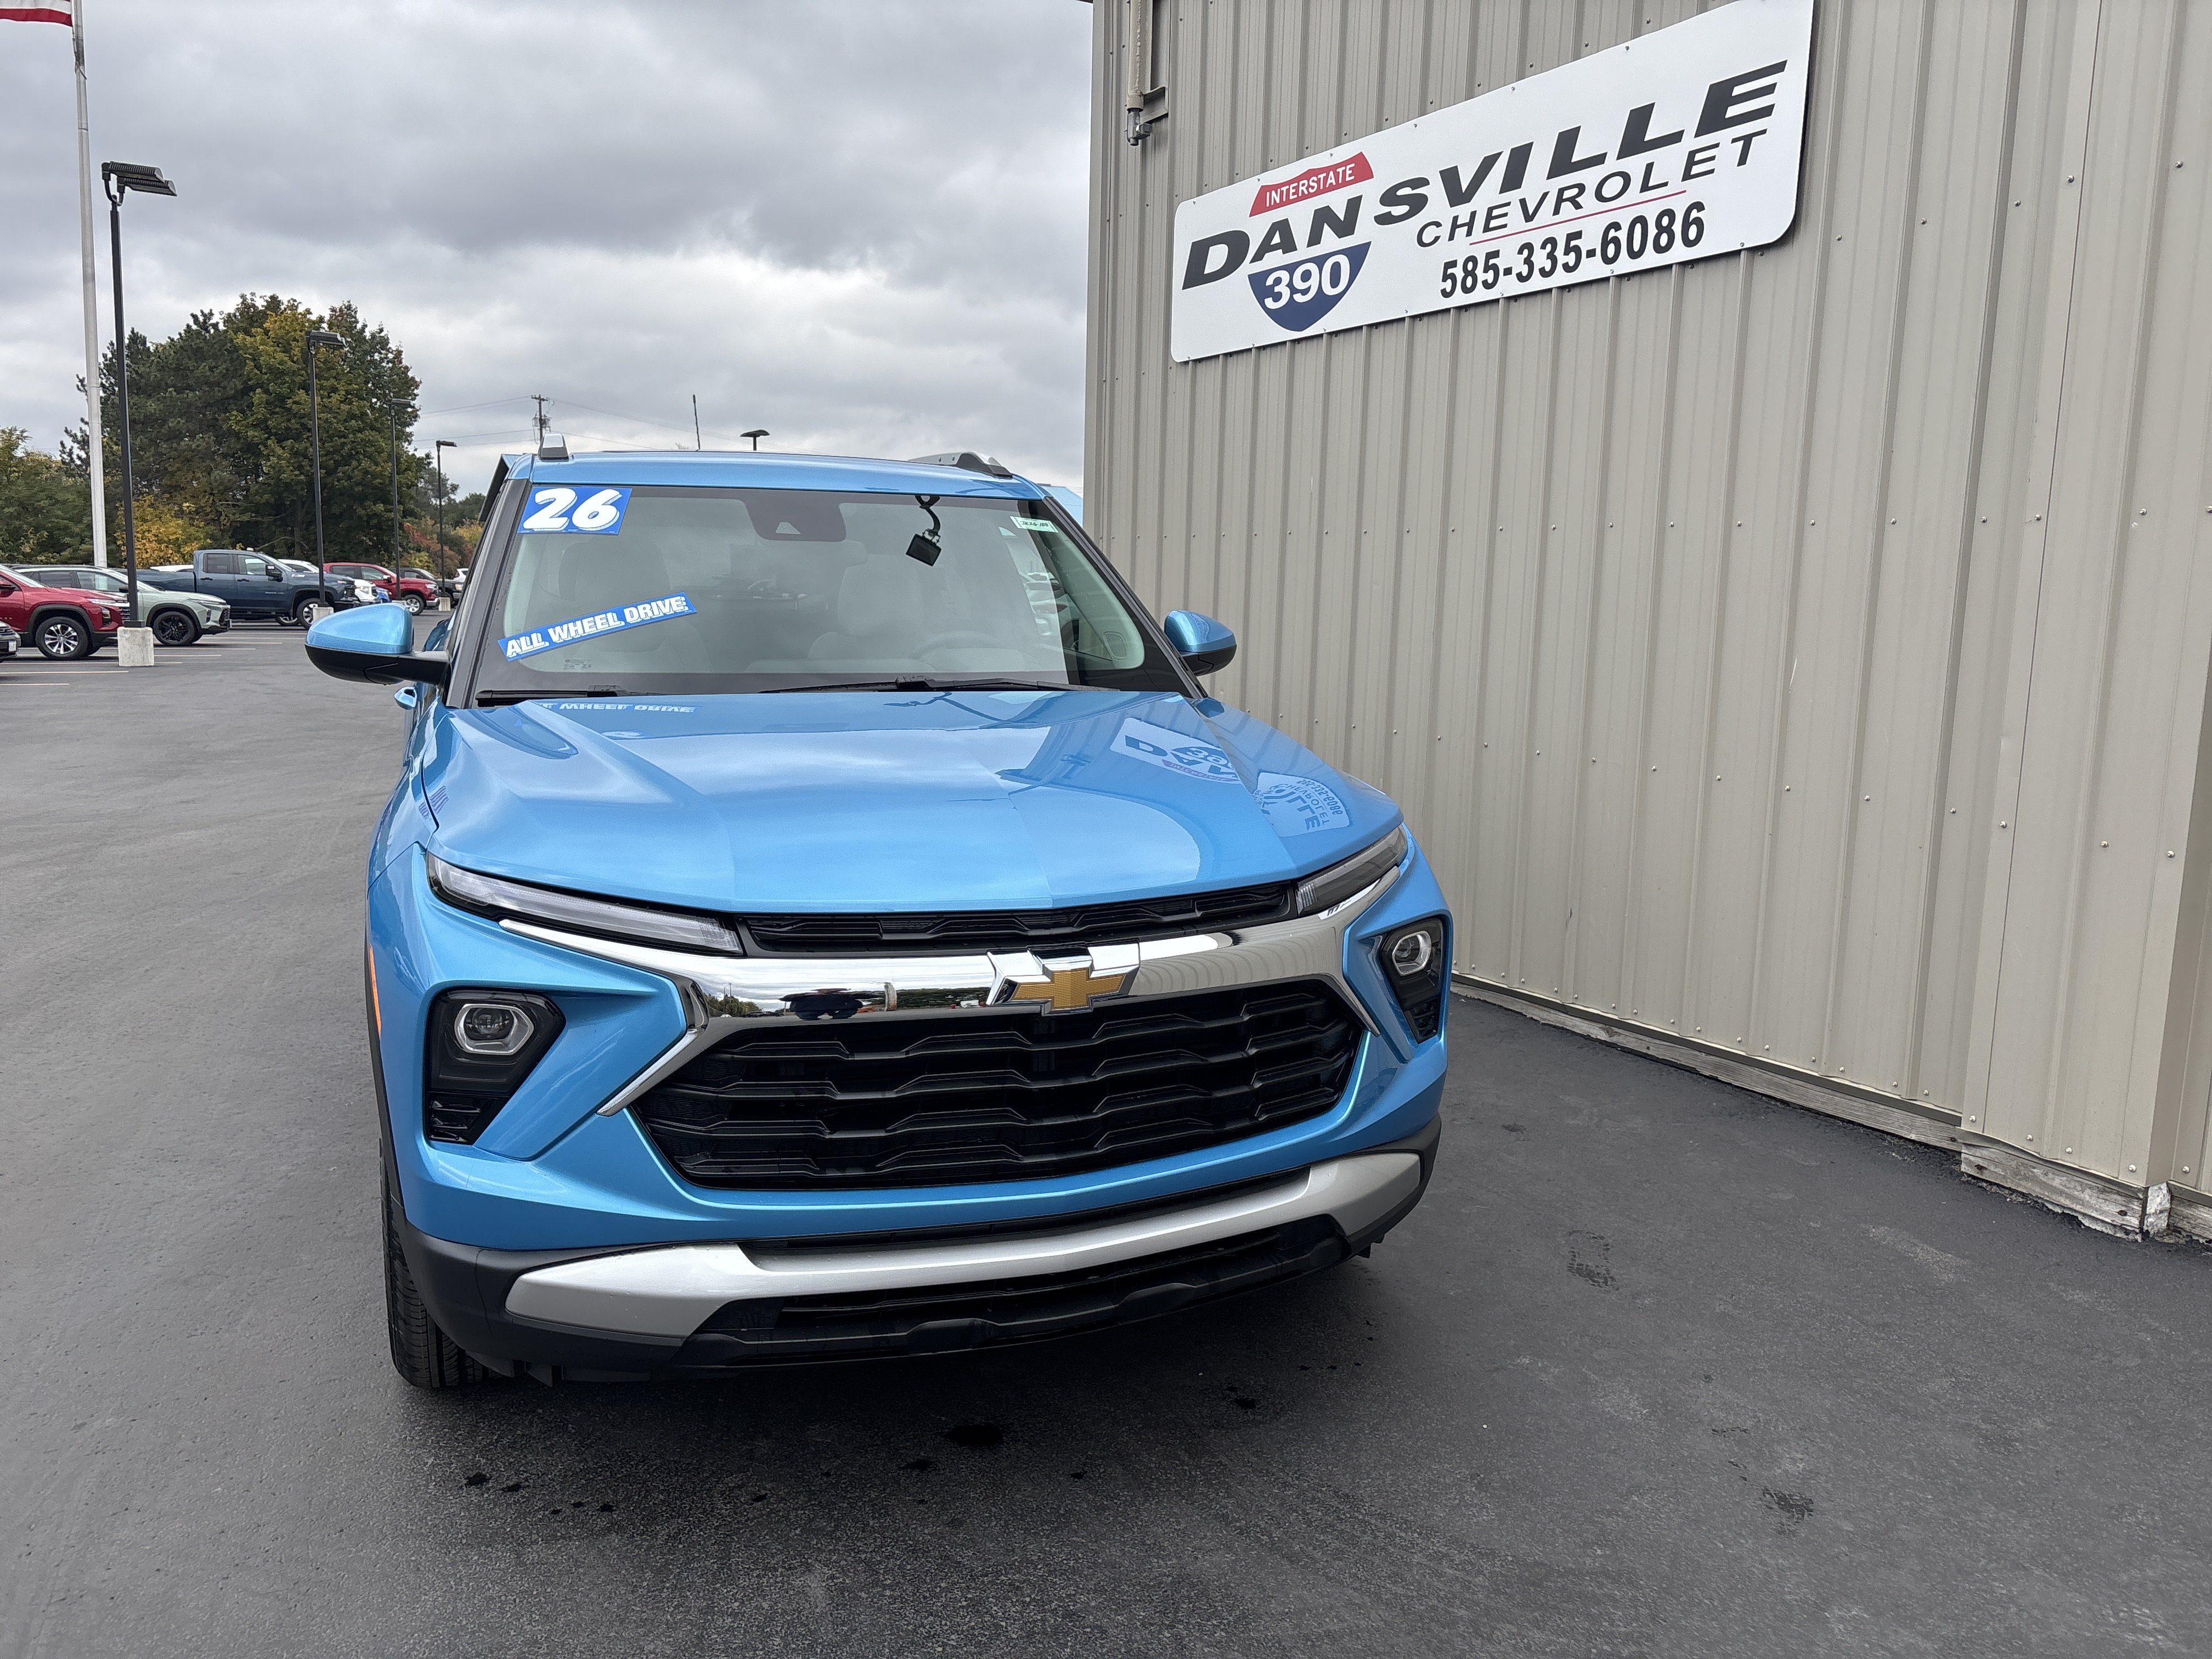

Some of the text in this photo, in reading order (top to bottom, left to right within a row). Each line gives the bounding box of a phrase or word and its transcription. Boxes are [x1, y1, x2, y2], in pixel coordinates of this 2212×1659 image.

[1182, 59, 1788, 290] DANSVILLE
[1265, 163, 1356, 208] INTERSTATE
[1416, 128, 1767, 249] CHEVROLET
[1440, 201, 1705, 300] 585-335-6086
[1263, 253, 1350, 311] 390
[523, 488, 623, 531] 26
[506, 596, 689, 658] ALL WHEEL DRIVE
